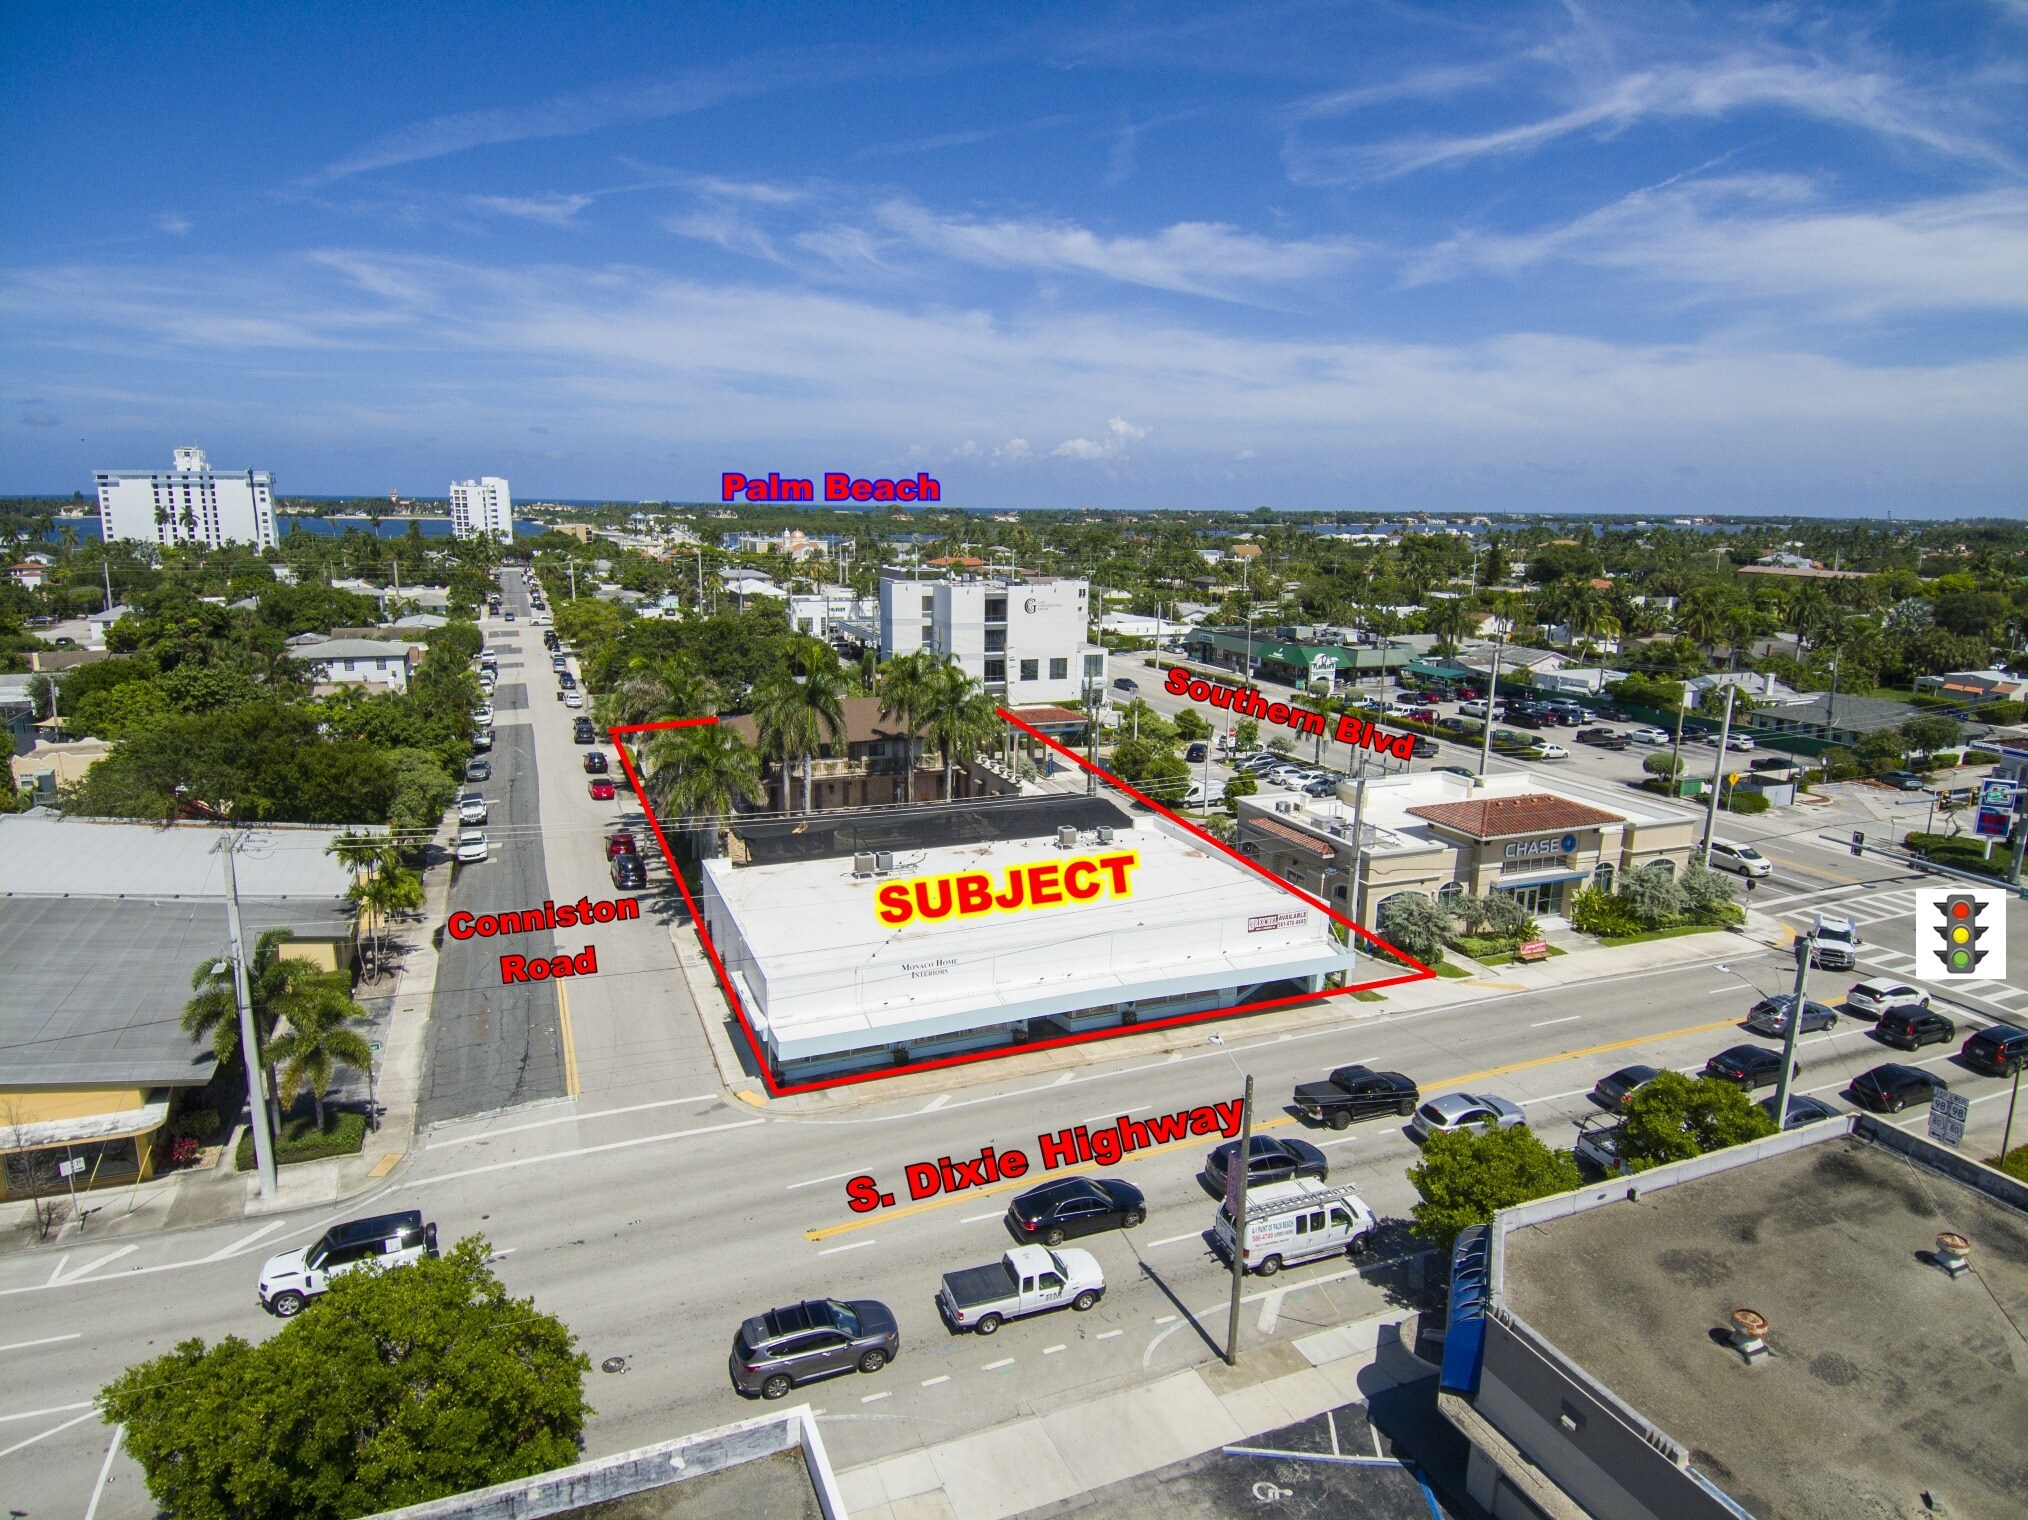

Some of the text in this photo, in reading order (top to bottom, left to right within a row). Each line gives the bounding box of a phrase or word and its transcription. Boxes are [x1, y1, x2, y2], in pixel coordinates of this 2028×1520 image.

[1504, 838, 1560, 858] CHASE
[1278, 912, 1307, 920] AVAILABLE
[901, 959, 958, 971] MONACO HOME
[911, 969, 949, 979] INTERIORS
[1934, 1099, 1946, 1111] 98
[1952, 1106, 1964, 1118] 98
[1268, 1223, 1273, 1232] OF
[1282, 1220, 1294, 1229] BEACH
